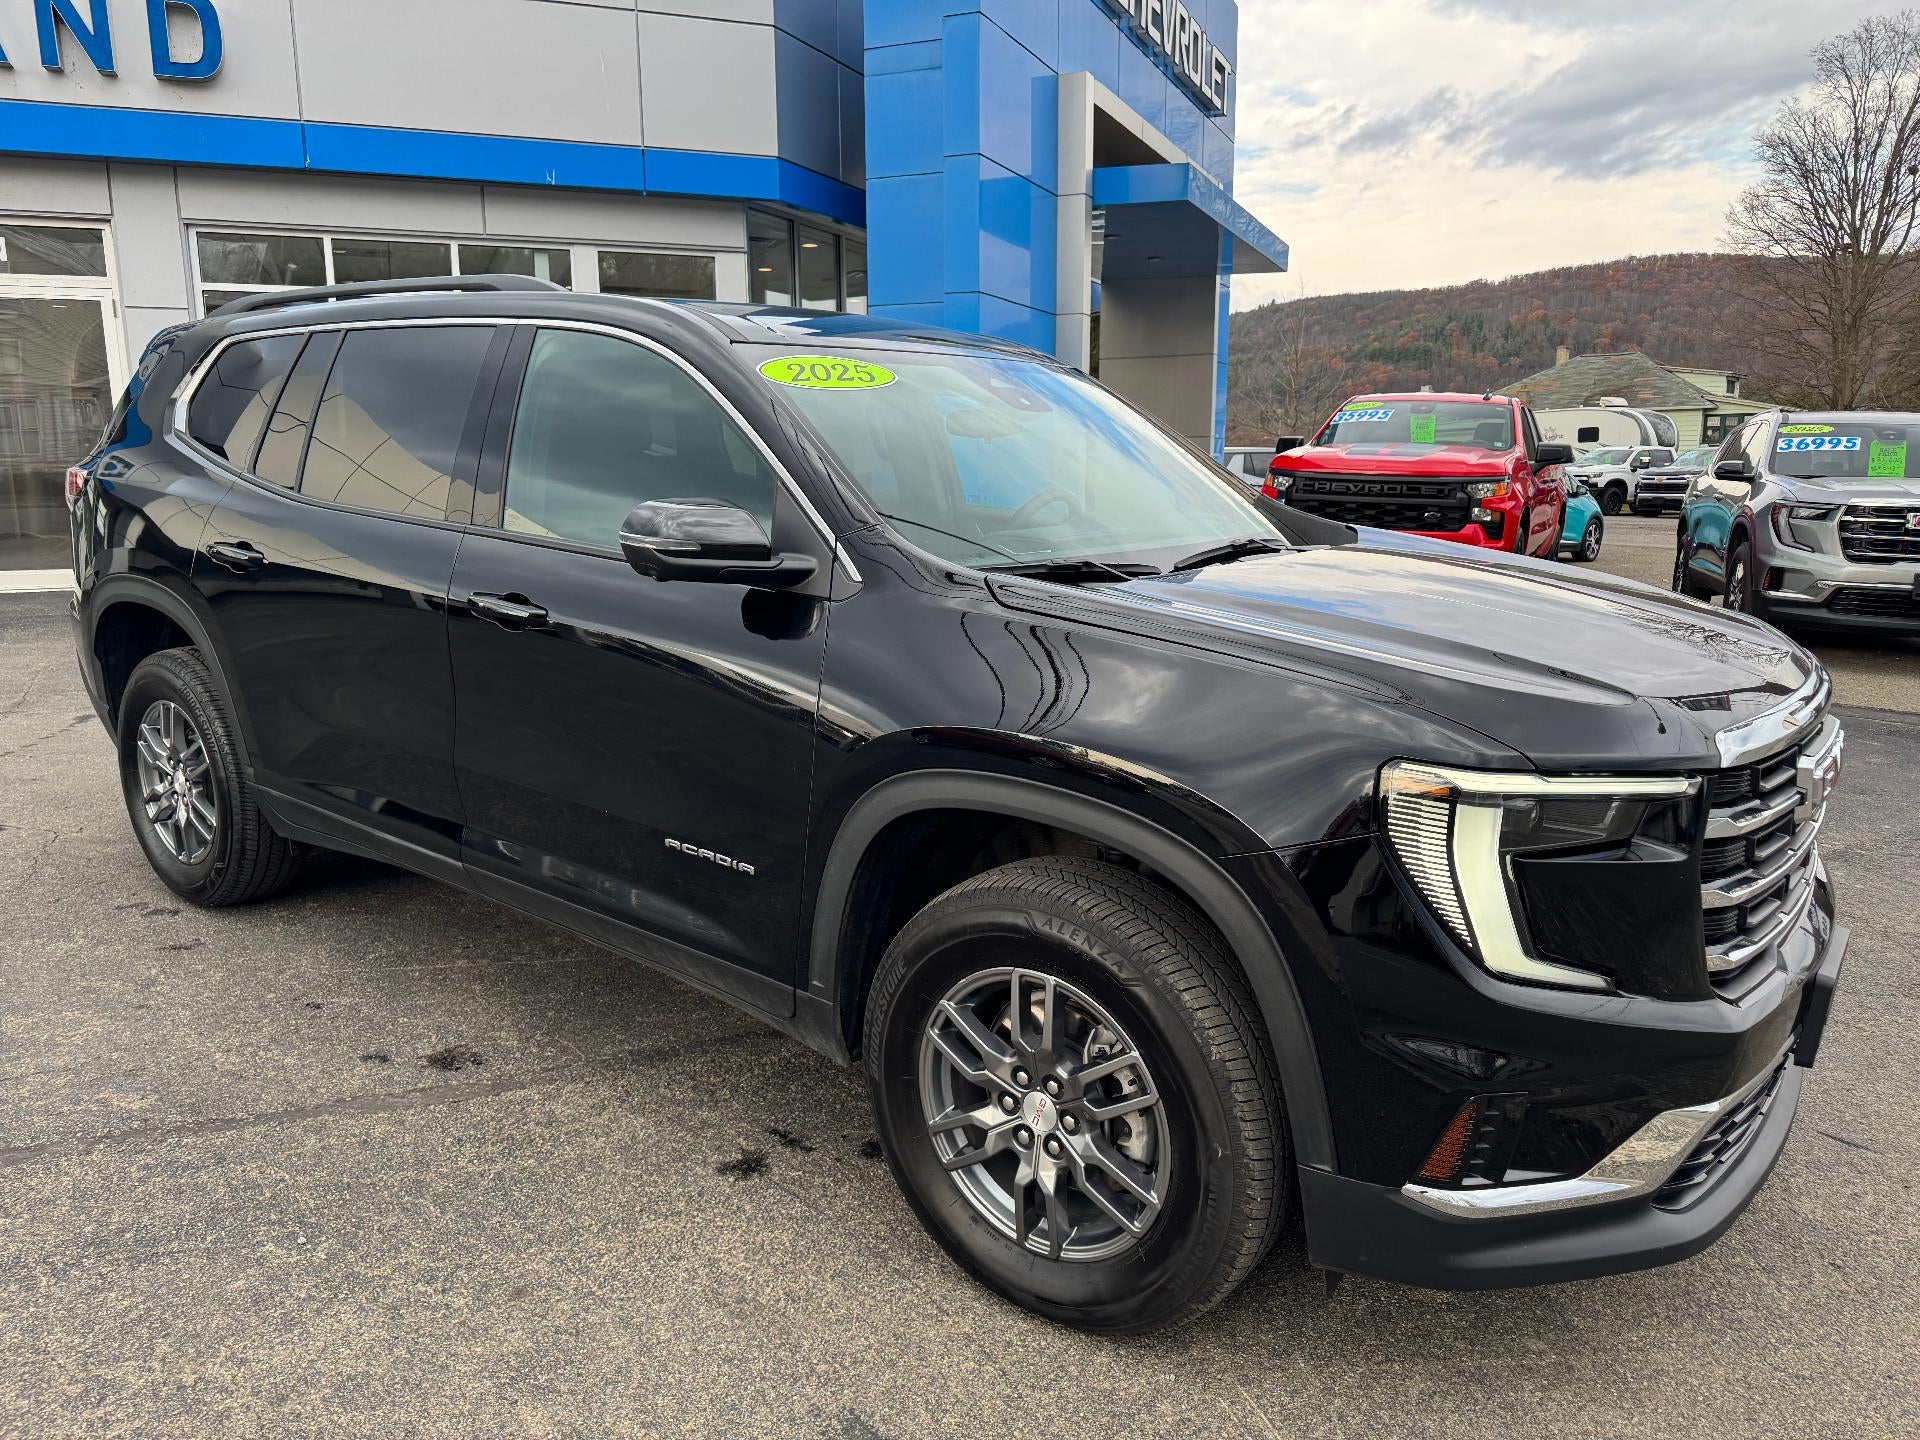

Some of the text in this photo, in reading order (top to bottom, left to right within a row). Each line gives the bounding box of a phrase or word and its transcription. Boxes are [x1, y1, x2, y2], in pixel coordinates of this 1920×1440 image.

[0, 0, 223, 78] ND
[787, 363, 876, 383] 2025
[1333, 410, 1393, 422] 35995
[1779, 438, 1858, 451] 36995
[1299, 481, 1457, 496] CHEVROLET
[664, 838, 755, 876] ACADIA
[1041, 918, 1126, 974] ALENZA
[1031, 1097, 1047, 1127] GMC
